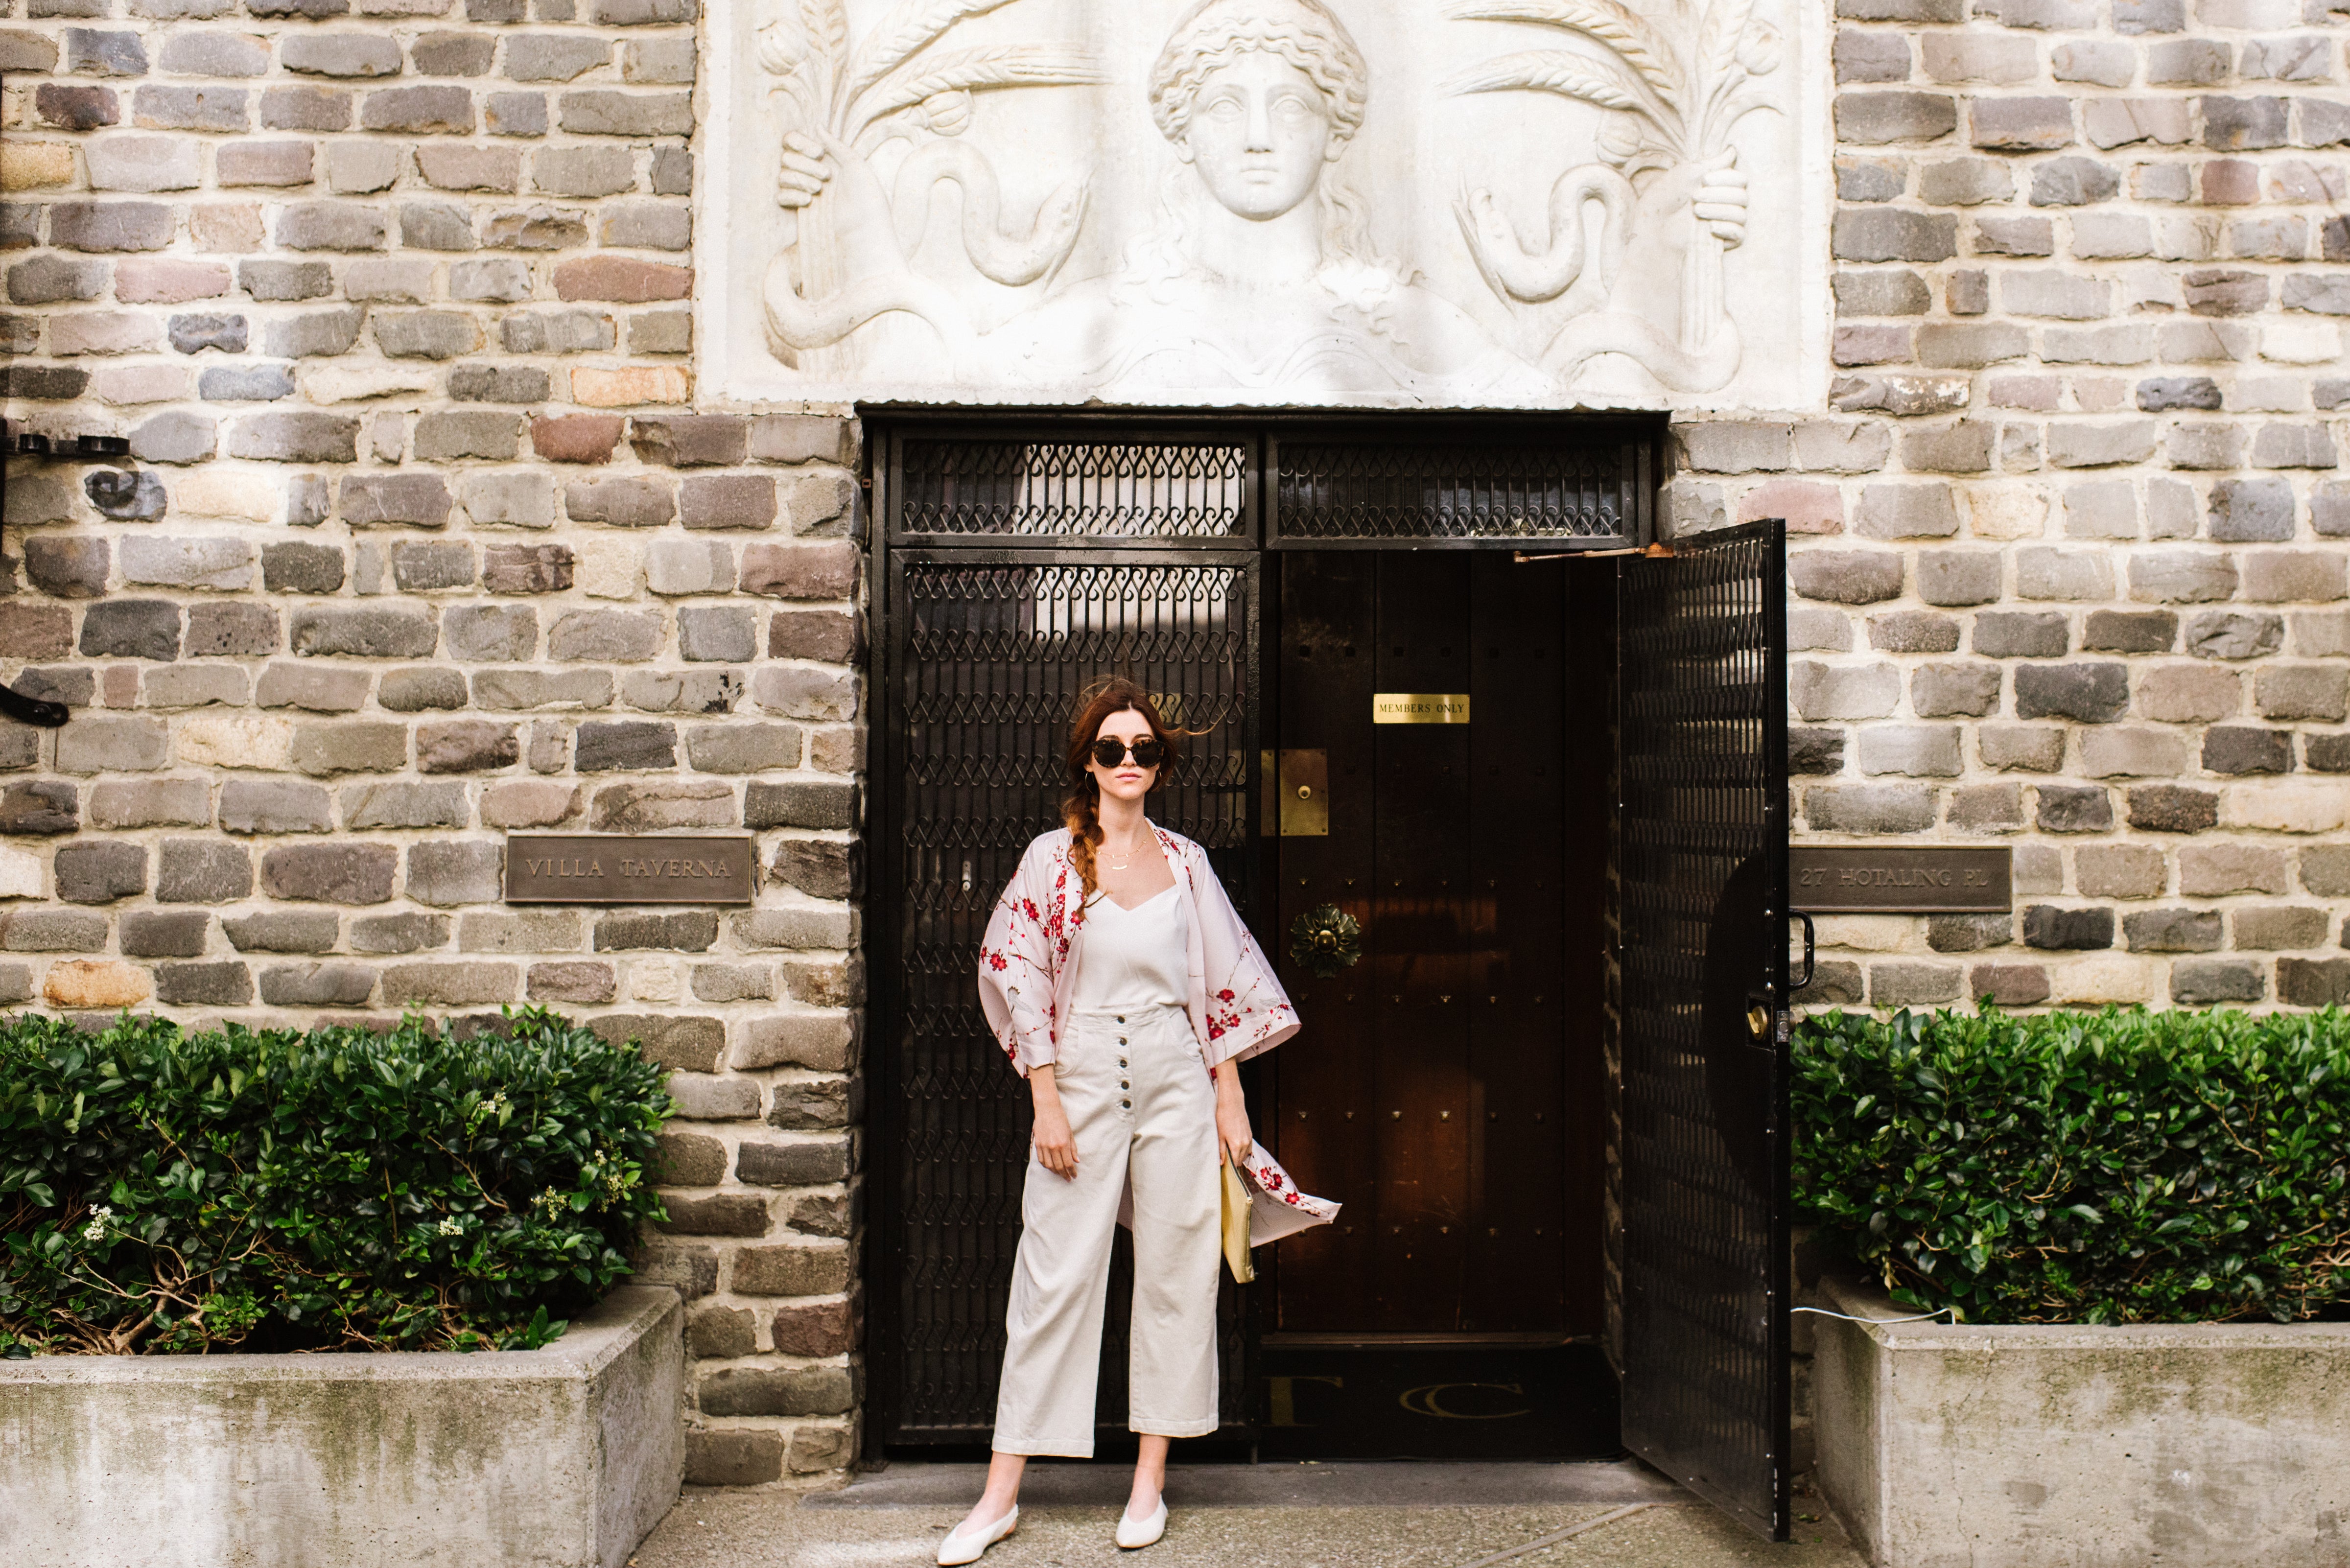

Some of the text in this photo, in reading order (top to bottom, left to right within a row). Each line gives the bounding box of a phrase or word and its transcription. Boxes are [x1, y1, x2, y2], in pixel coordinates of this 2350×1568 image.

[1379, 703, 1464, 713] MEMBERS ONLY
[525, 859, 732, 878] VILLA TAVERNA
[1800, 868, 1989, 887] 27 HOTALING PL
